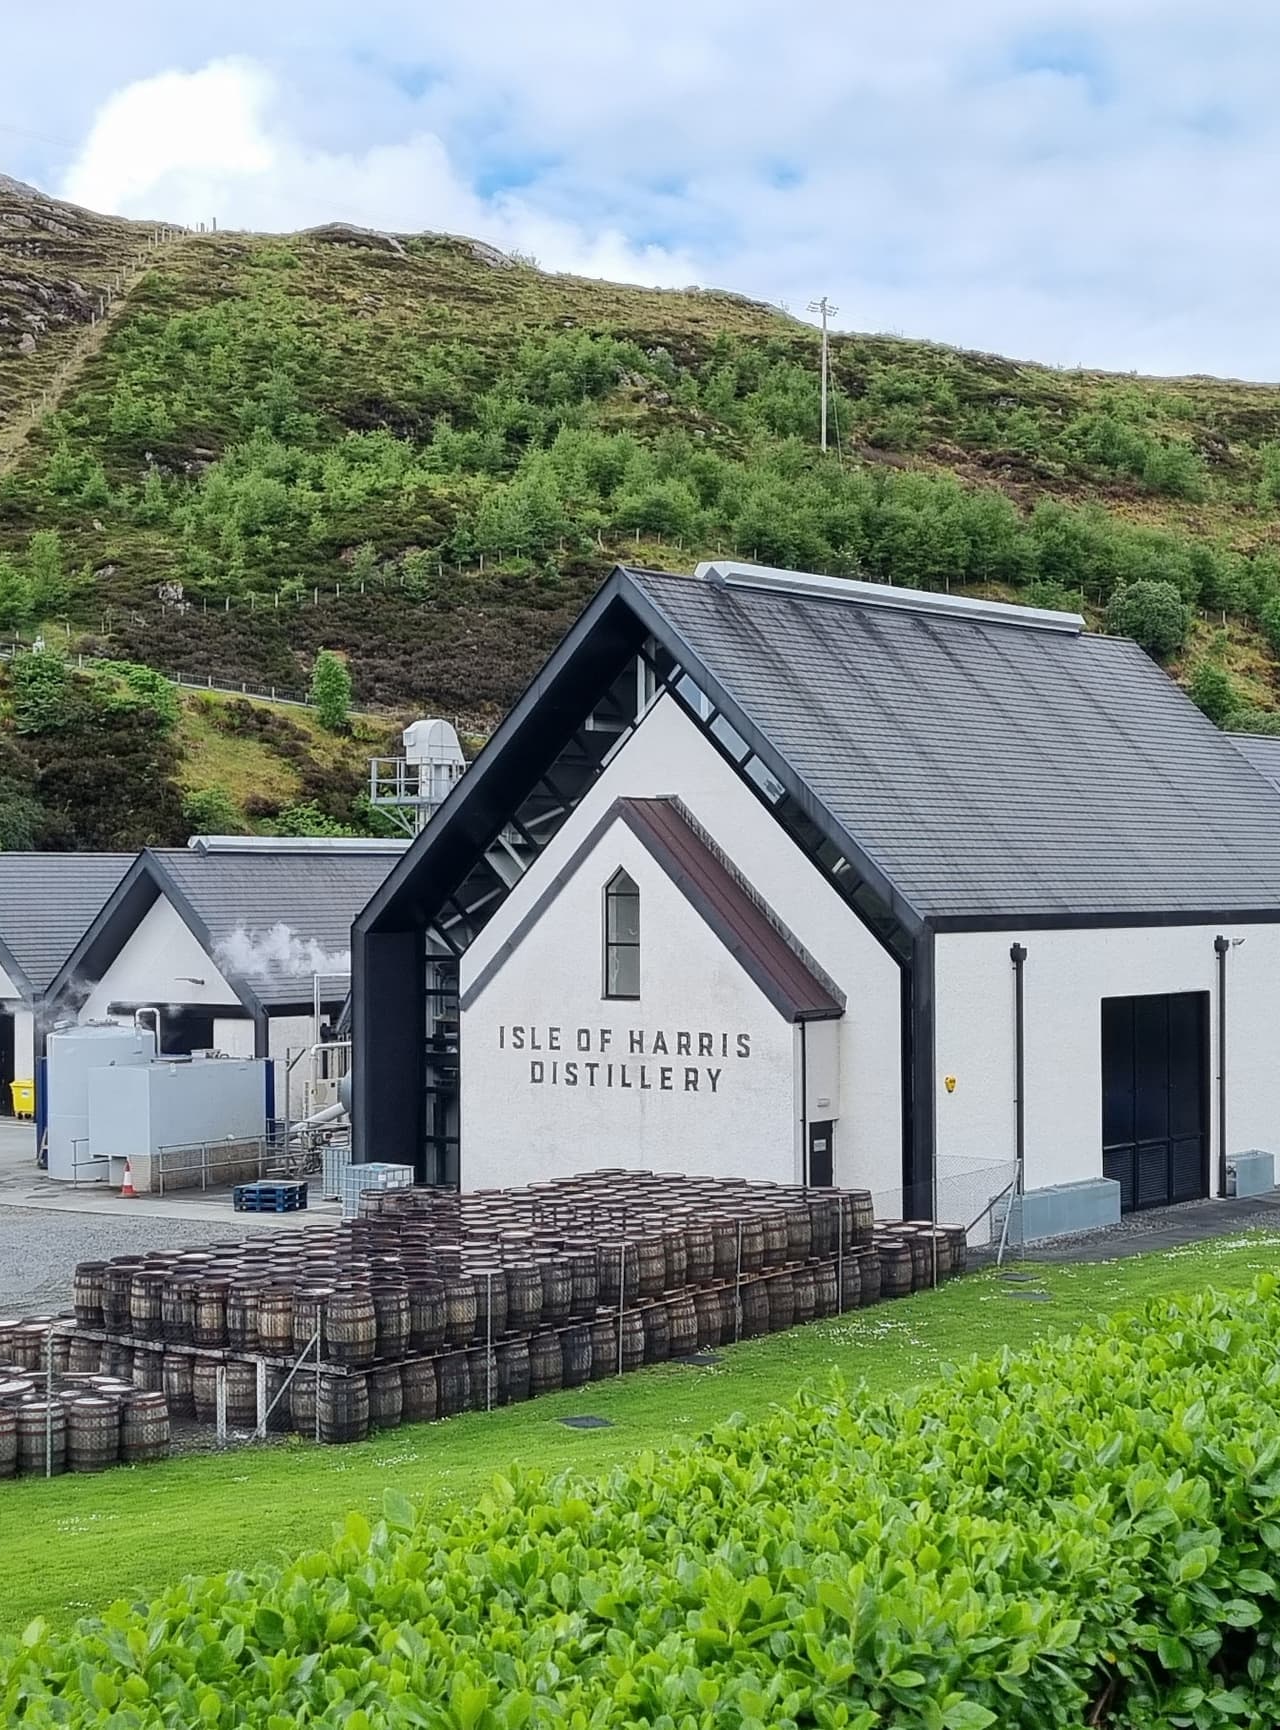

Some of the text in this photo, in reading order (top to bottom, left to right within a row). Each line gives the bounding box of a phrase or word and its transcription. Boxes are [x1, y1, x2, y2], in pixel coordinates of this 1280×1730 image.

[499, 1025, 751, 1058] ISLE OF HARRIS
[530, 1060, 722, 1093] DISTILLERY
